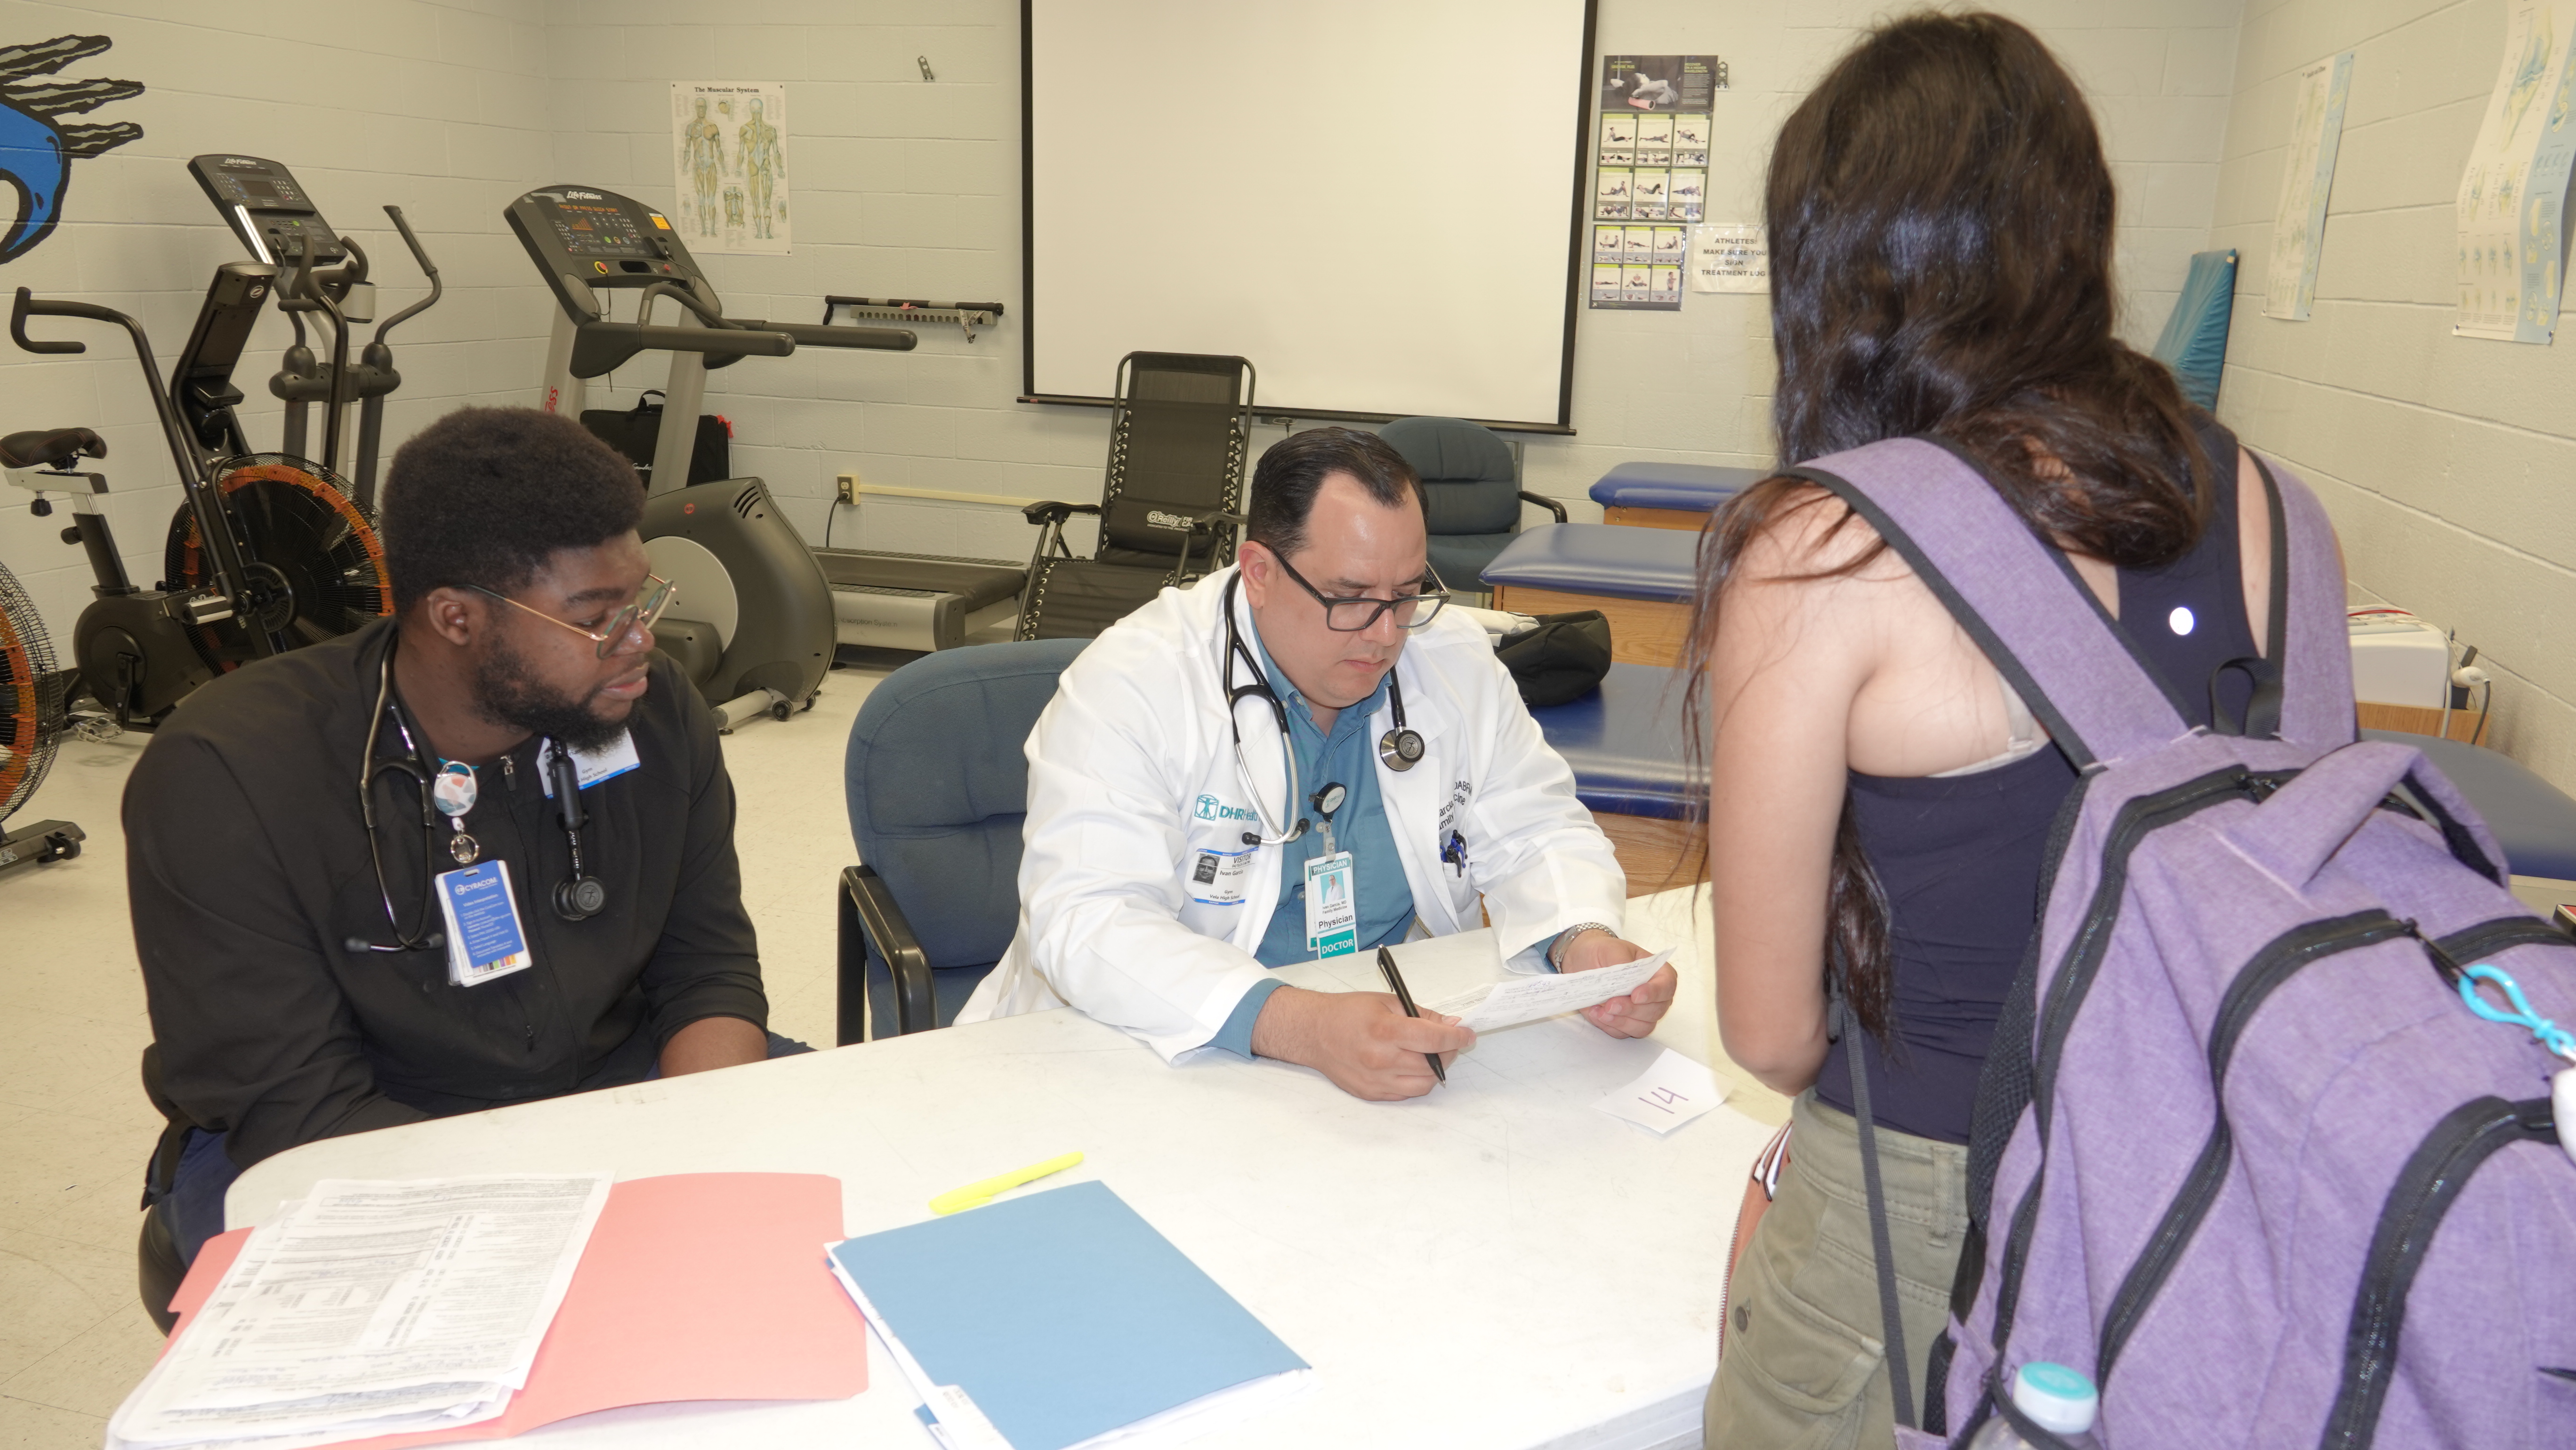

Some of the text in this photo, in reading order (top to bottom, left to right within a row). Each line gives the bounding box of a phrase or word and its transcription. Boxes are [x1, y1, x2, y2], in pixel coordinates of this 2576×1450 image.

[1147, 511, 1182, 527] O'Reilly
[1234, 854, 1251, 863] VISITOR
[1313, 860, 1347, 874] PHYSICIAN
[465, 877, 498, 891] CYRACOM
[1319, 915, 1353, 929] Physician
[1322, 939, 1353, 954] DOCTOR
[1638, 1087, 1689, 1114] 14
